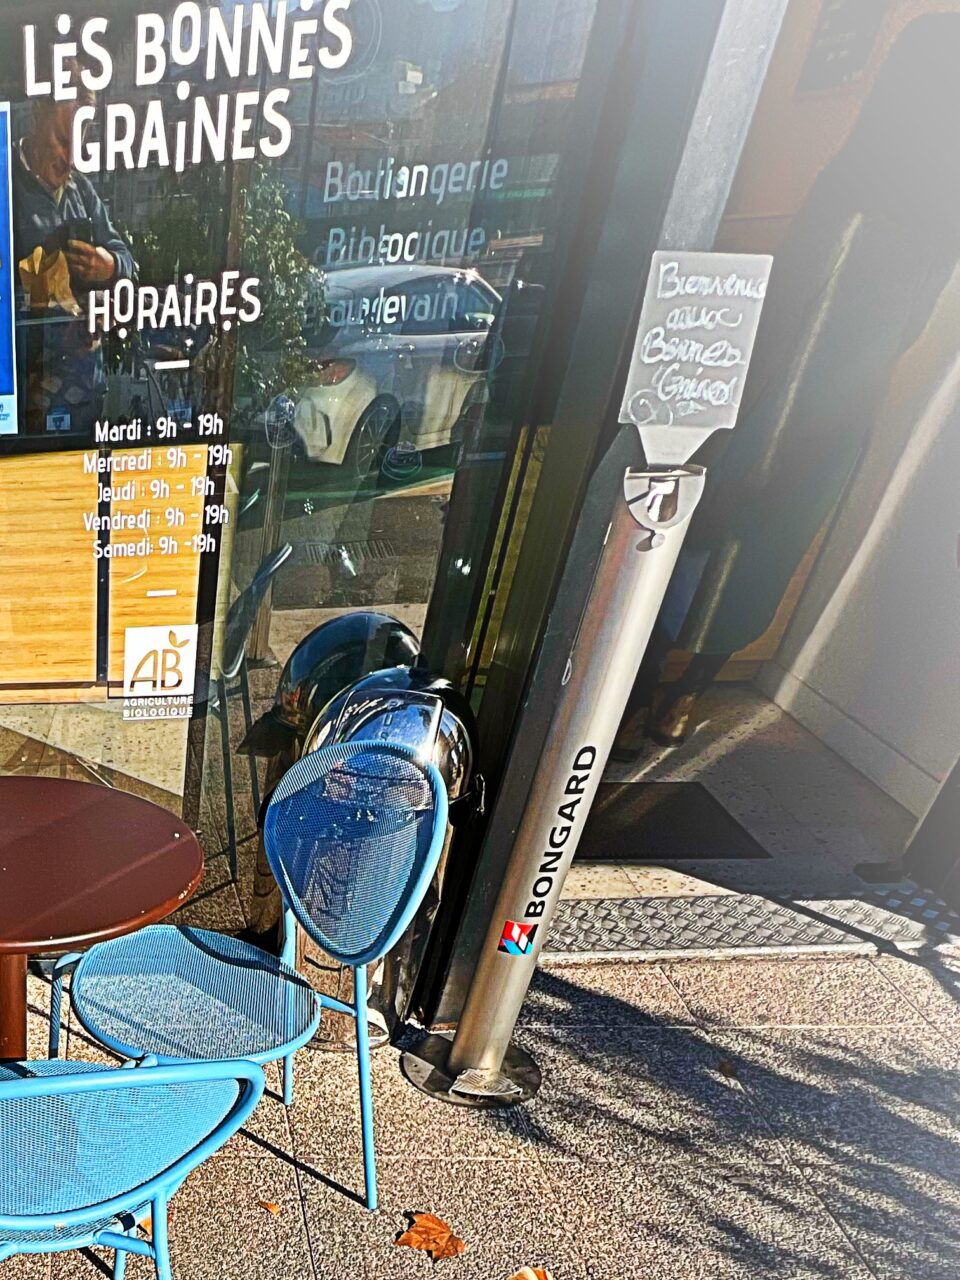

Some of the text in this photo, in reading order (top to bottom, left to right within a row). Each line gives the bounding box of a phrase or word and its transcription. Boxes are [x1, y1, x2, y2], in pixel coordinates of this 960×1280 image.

[135, 0, 353, 87] BONNES
[95, 418, 141, 442] Mardi
[156, 416, 177, 438] 9h
[198, 413, 224, 436] 19h
[83, 449, 152, 473] Mercredi
[167, 448, 187, 468] 9h
[208, 445, 233, 466] 19h
[97, 481, 136, 503] Jeudi
[150, 479, 170, 499] 9h
[191, 476, 215, 496] 19h
[83, 509, 151, 531] Vendredi
[165, 508, 184, 527] 9h
[205, 504, 229, 525] 19h
[159, 536, 178, 555] 9h
[129, 648, 183, 692] AB
[123, 695, 194, 707] AGRICULTURE
[123, 707, 193, 718] BIOLOGIQUE
[524, 745, 597, 917] BONGARD
